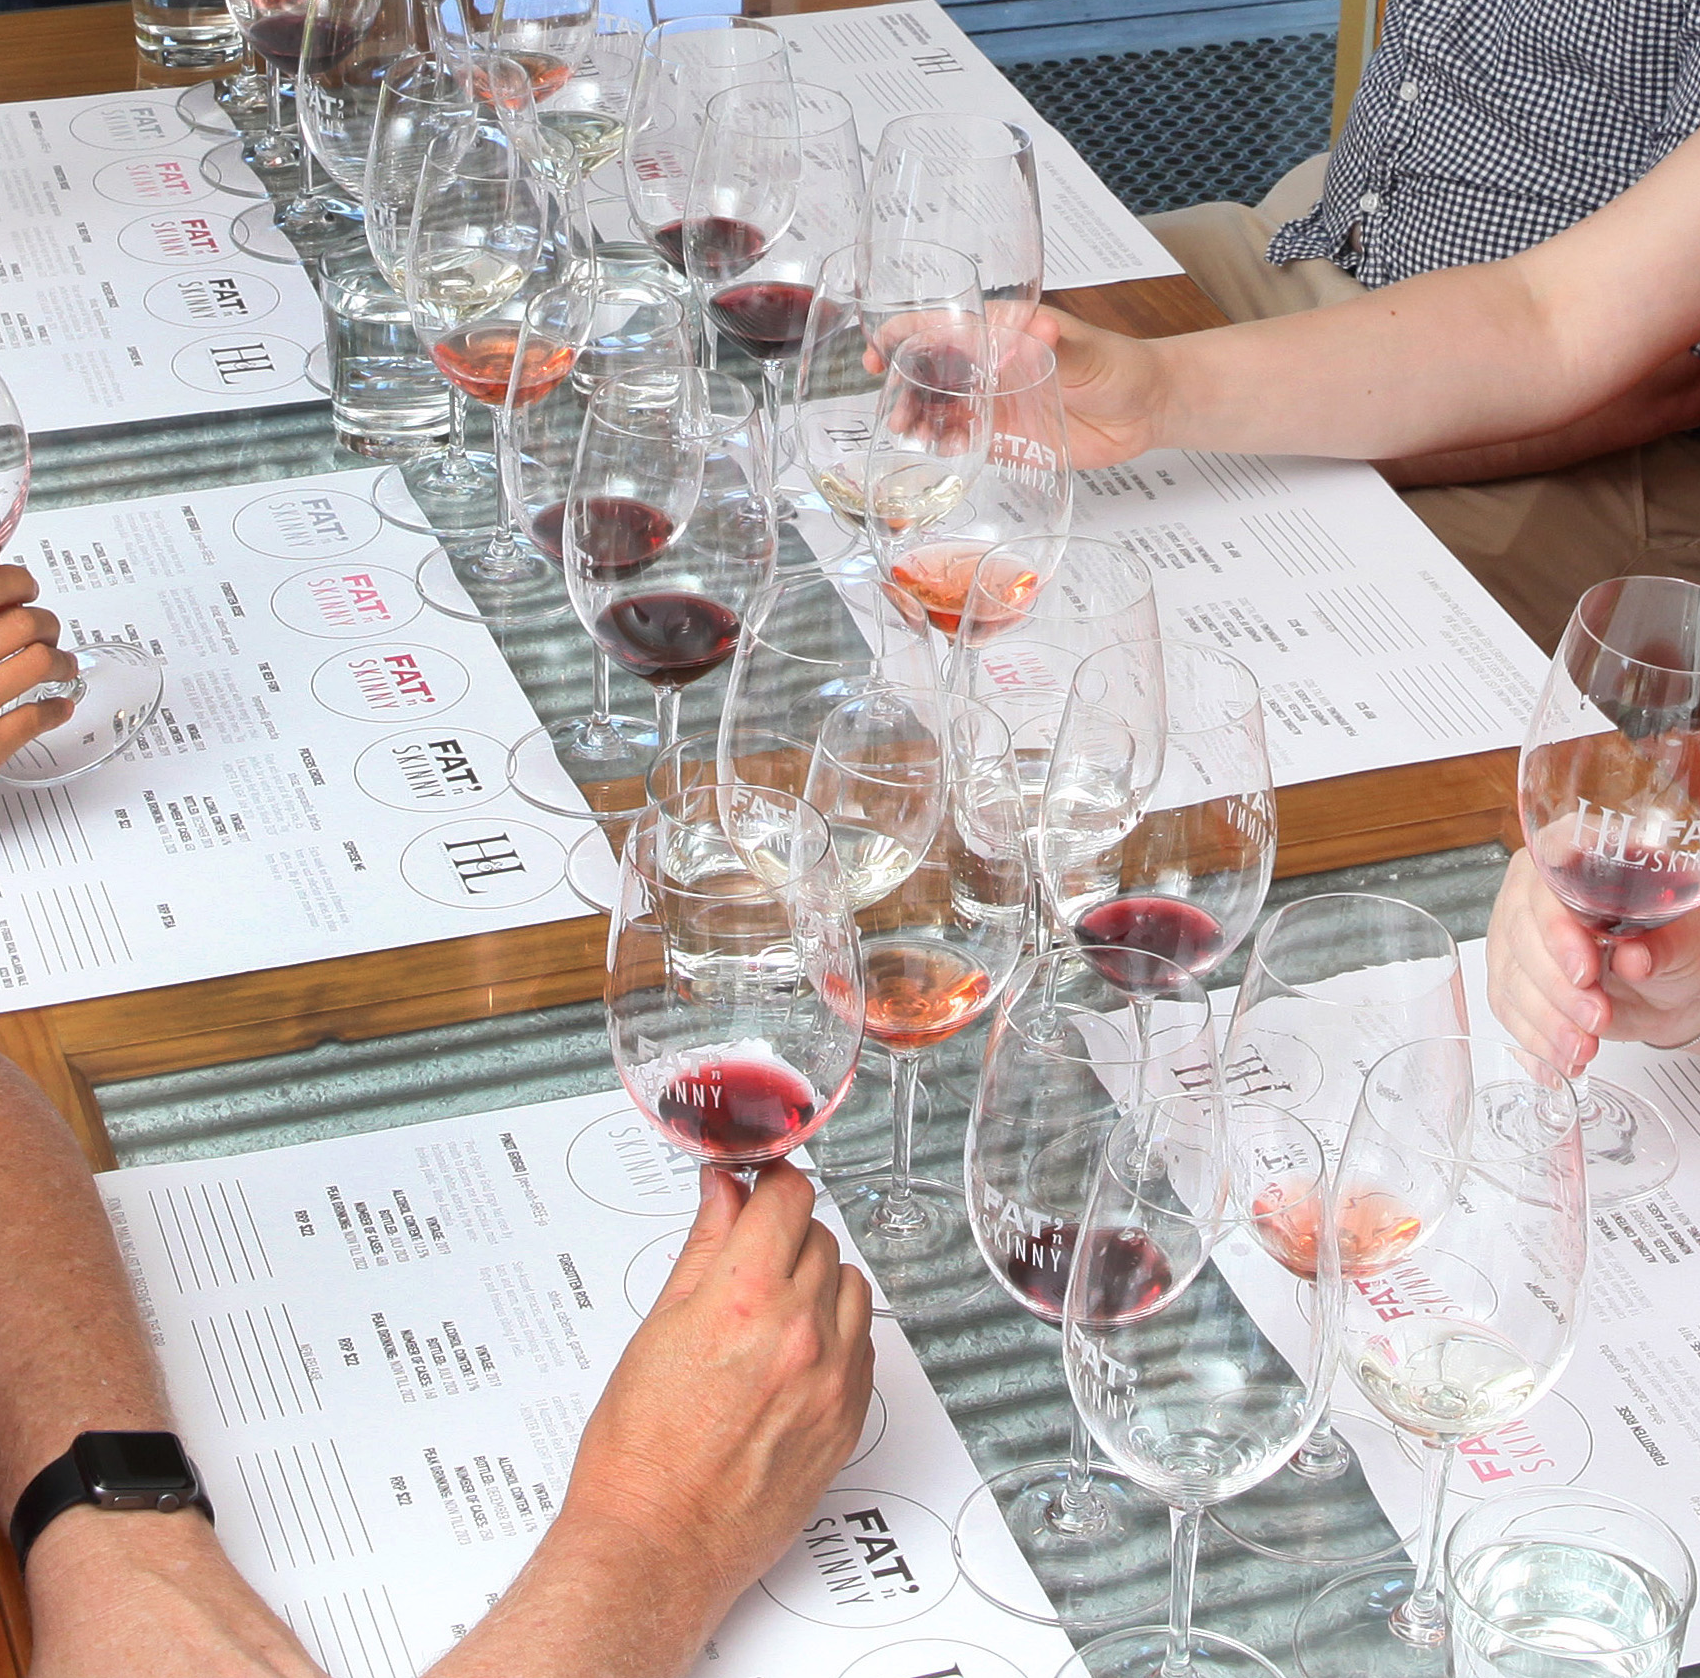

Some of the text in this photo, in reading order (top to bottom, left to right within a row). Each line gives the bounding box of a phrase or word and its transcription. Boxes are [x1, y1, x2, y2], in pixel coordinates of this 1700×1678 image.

[126, 164, 161, 197] SKINNY
[151, 221, 189, 256] SKINNY
[178, 281, 217, 318] SKINNY
[268, 502, 316, 547] SKINNY
[307, 579, 356, 626] SKINNY
[348, 660, 400, 709] SKINNY
[392, 745, 445, 798] SKINNY
[444, 833, 526, 894] H&L
[608, 1127, 671, 1196] SKINNY
[326, 1186, 341, 1202] PEAK
[294, 1210, 310, 1223] RRP
[983, 1214, 1062, 1272] SKINNY
[557, 1253, 583, 1290] FORGOTTEN
[371, 1313, 387, 1329] PEAK
[441, 1322, 462, 1349] ALCOHOL
[338, 1338, 359, 1366] RRP $22
[401, 1330, 420, 1356] NUMBER
[411, 1356, 424, 1364] OF
[423, 1448, 440, 1465] PEAK
[1630, 1426, 1669, 1466] FORGOTTEN
[454, 1466, 475, 1494] NUMBER
[466, 1495, 479, 1503] OF
[497, 1457, 518, 1486] ALCOHOL
[390, 1476, 412, 1506] RRP $22
[444, 1499, 459, 1514] NOW
[451, 1515, 465, 1529] TILL
[486, 1486, 510, 1520] DECEMBER
[499, 1521, 517, 1536] 2019
[796, 1516, 873, 1604] SKINNY
